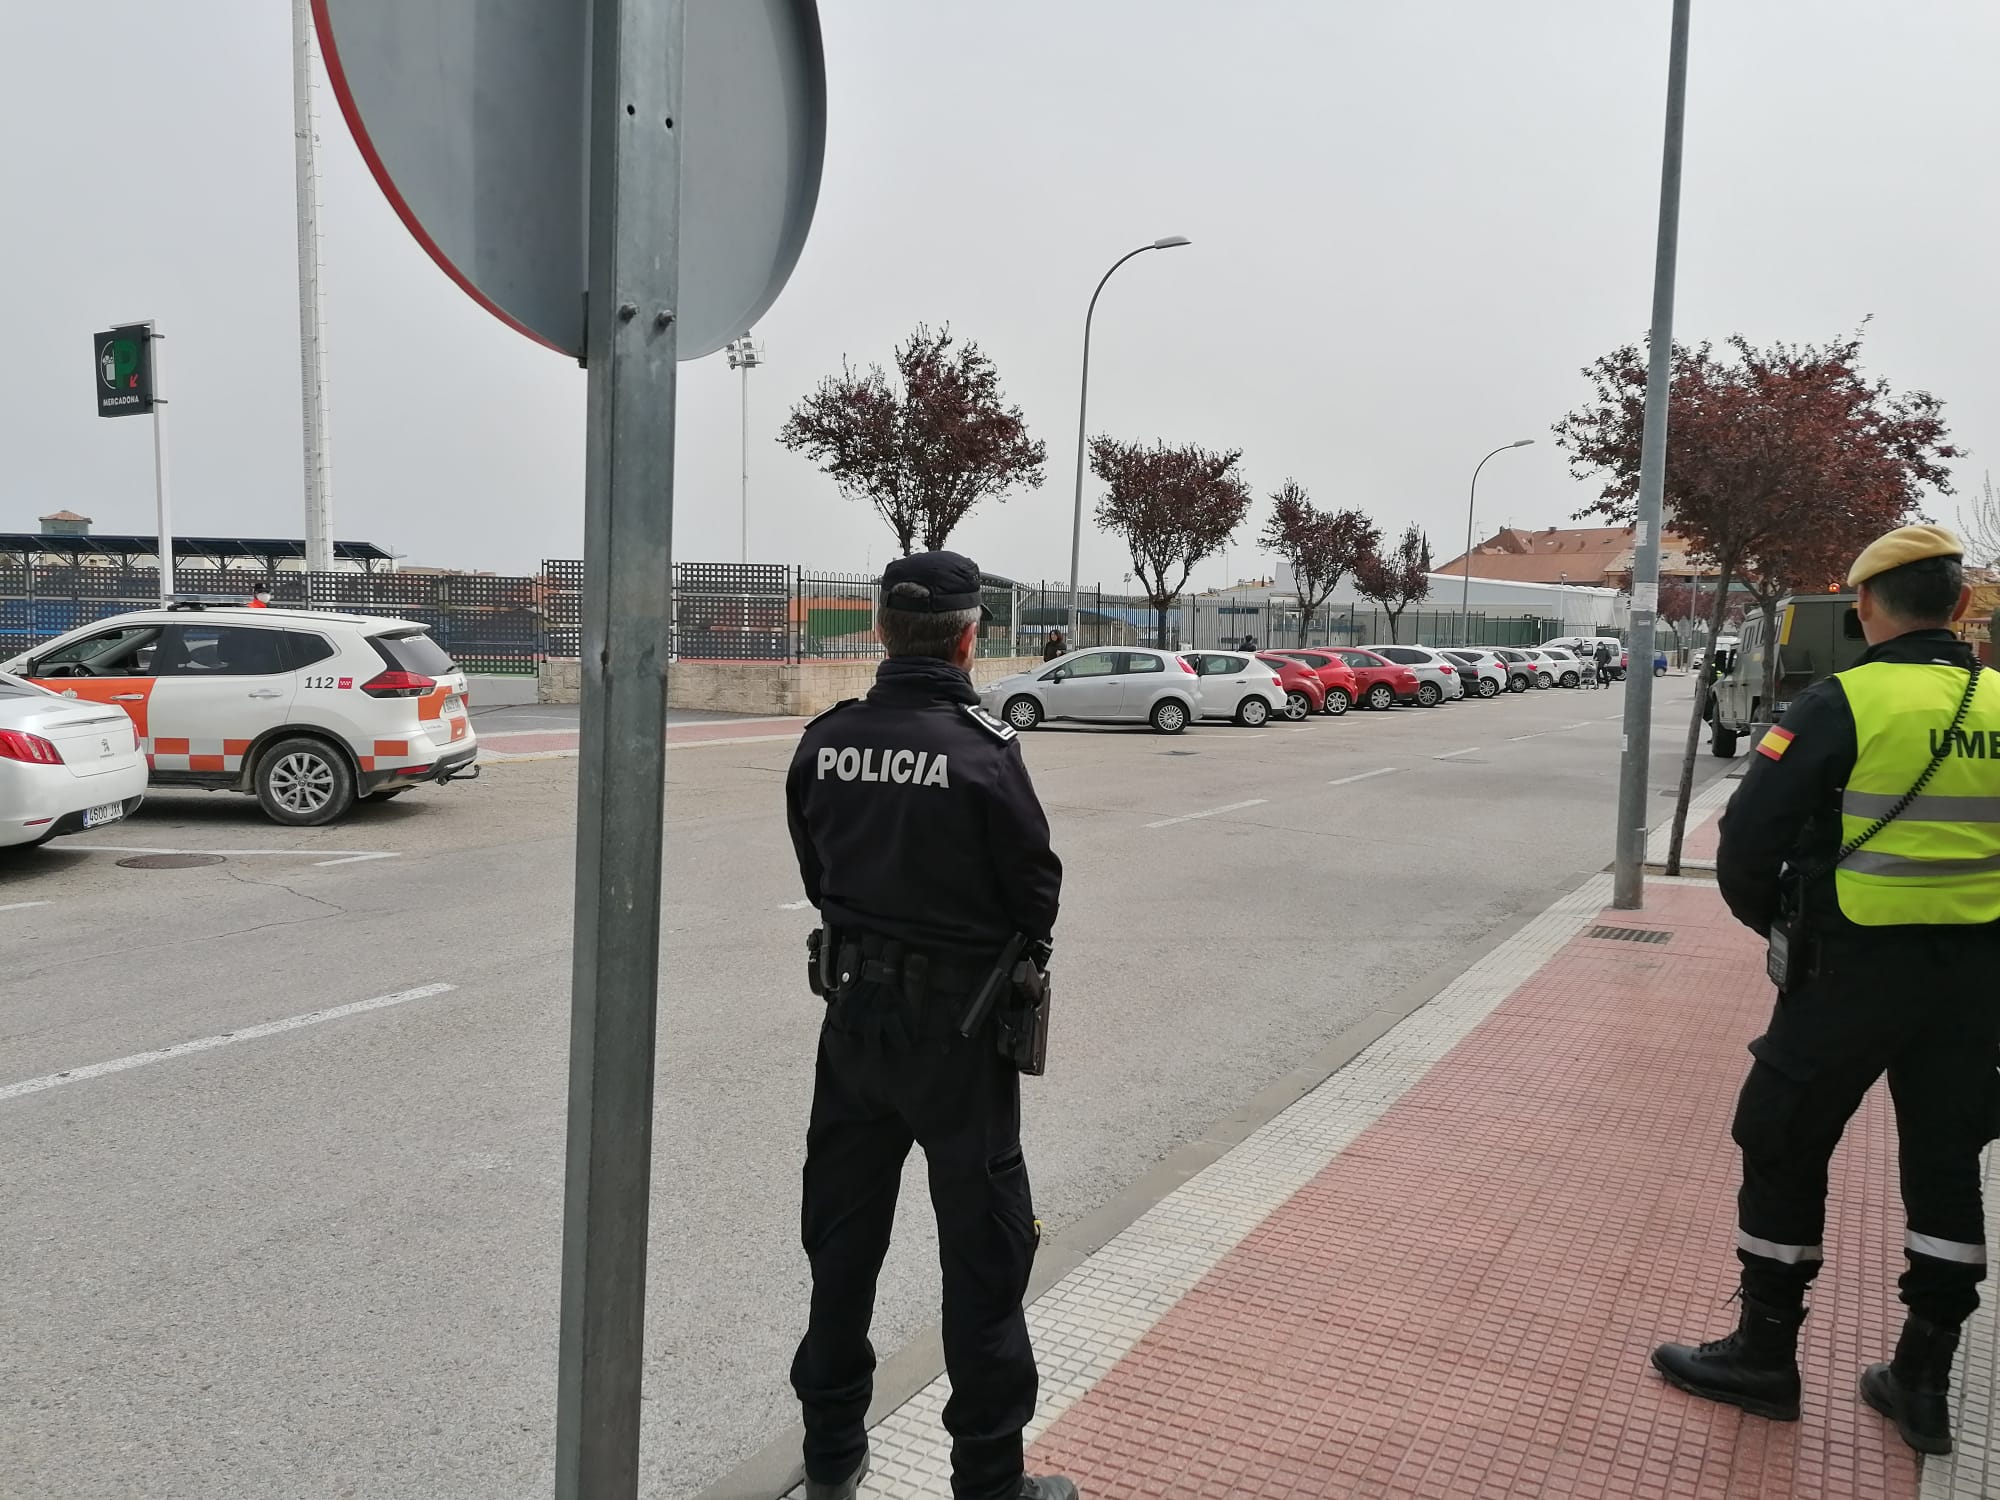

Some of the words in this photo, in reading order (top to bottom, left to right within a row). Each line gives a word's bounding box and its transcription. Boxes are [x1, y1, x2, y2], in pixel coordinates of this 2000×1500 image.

[114, 340, 137, 388] P
[102, 395, 140, 406] MERCADONA
[304, 676, 335, 689] 112
[817, 746, 950, 788] POLICIA
